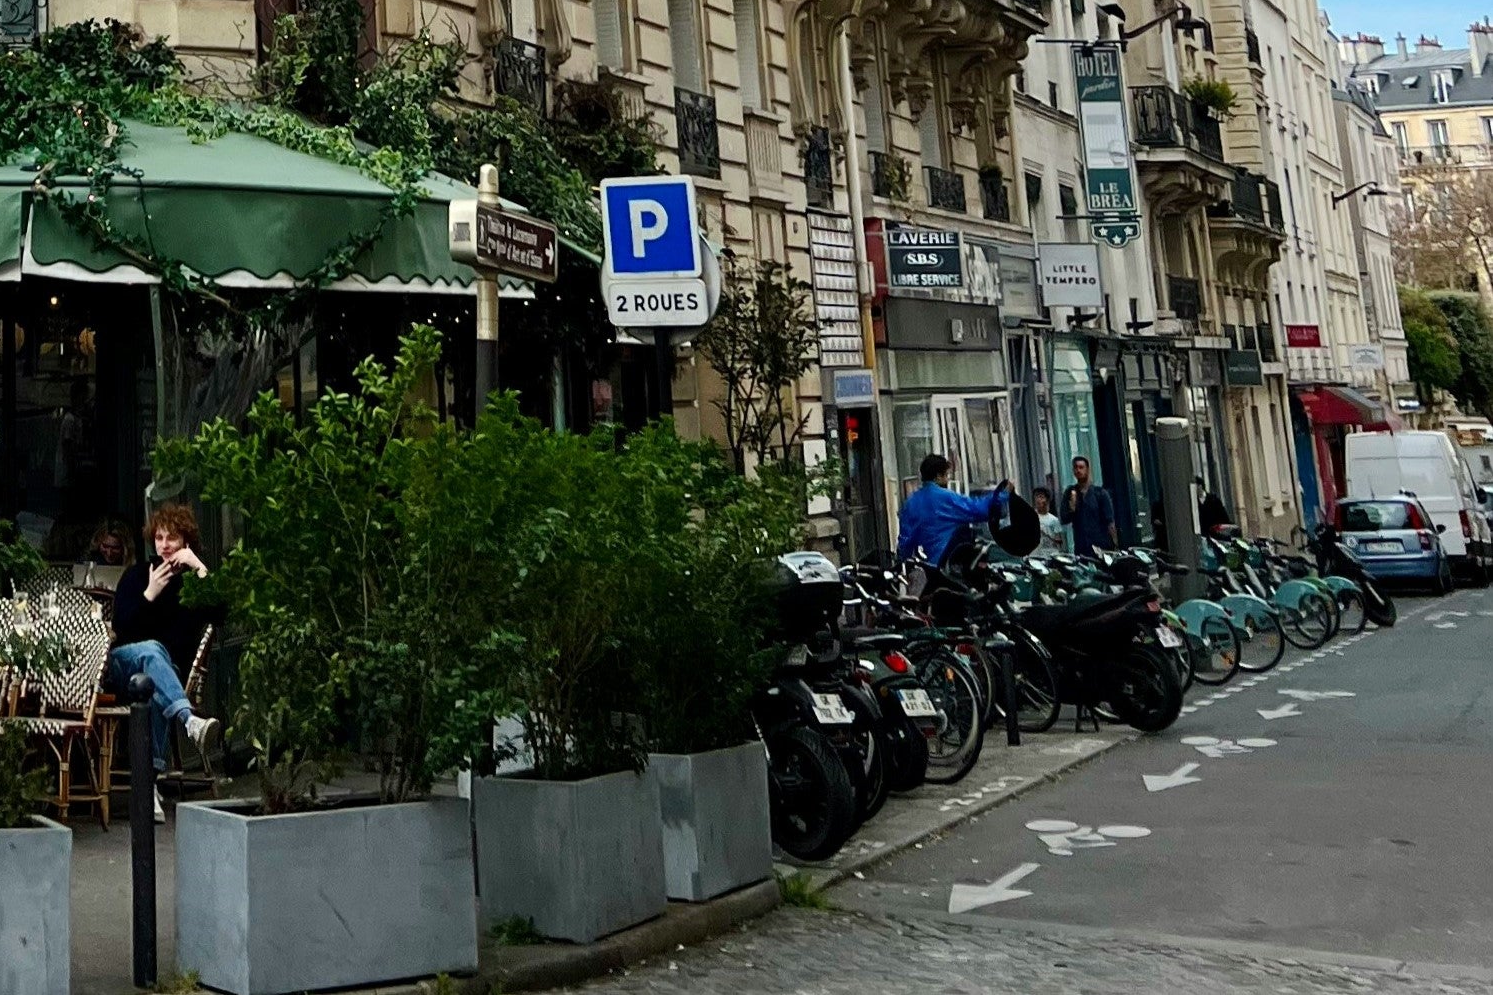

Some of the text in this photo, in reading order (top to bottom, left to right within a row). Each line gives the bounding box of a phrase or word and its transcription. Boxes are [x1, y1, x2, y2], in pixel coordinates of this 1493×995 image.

[1099, 182, 1119, 193] LE
[628, 199, 669, 258] P
[889, 232, 955, 244] LAVERIE
[1053, 265, 1087, 273] LITTLE
[892, 274, 960, 285] LIBRE SERVICE
[1045, 276, 1097, 285] TEMPERO
[616, 293, 699, 312] 2 ROUES
